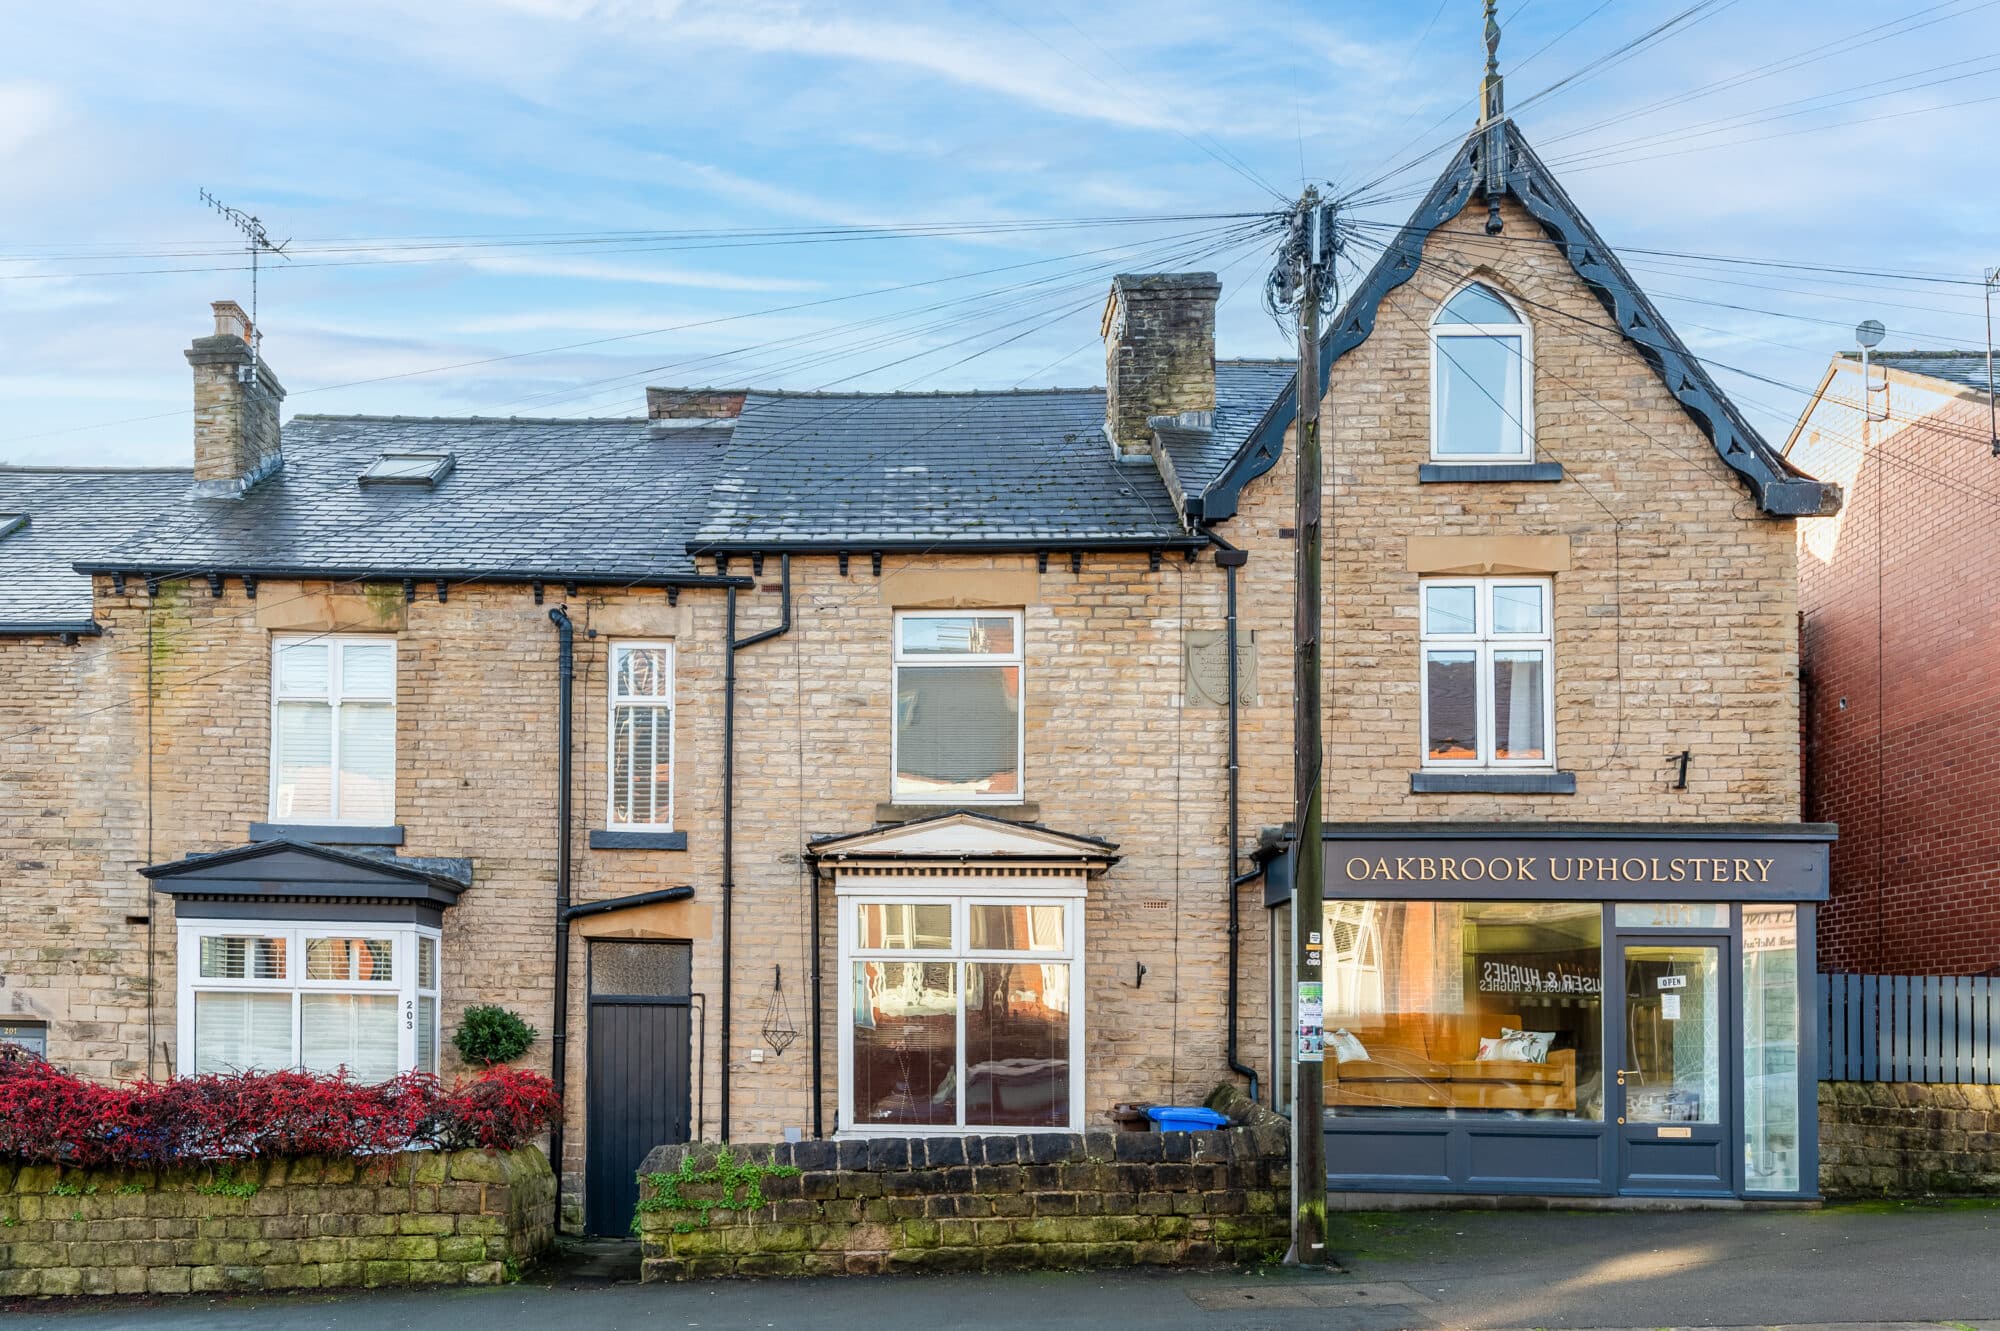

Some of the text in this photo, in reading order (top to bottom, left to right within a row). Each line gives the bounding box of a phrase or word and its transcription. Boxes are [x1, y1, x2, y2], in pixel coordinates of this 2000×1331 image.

[1346, 857, 1775, 882] OAKBROOK UPHOLSTERY
[1662, 978, 1681, 986] OPEN
